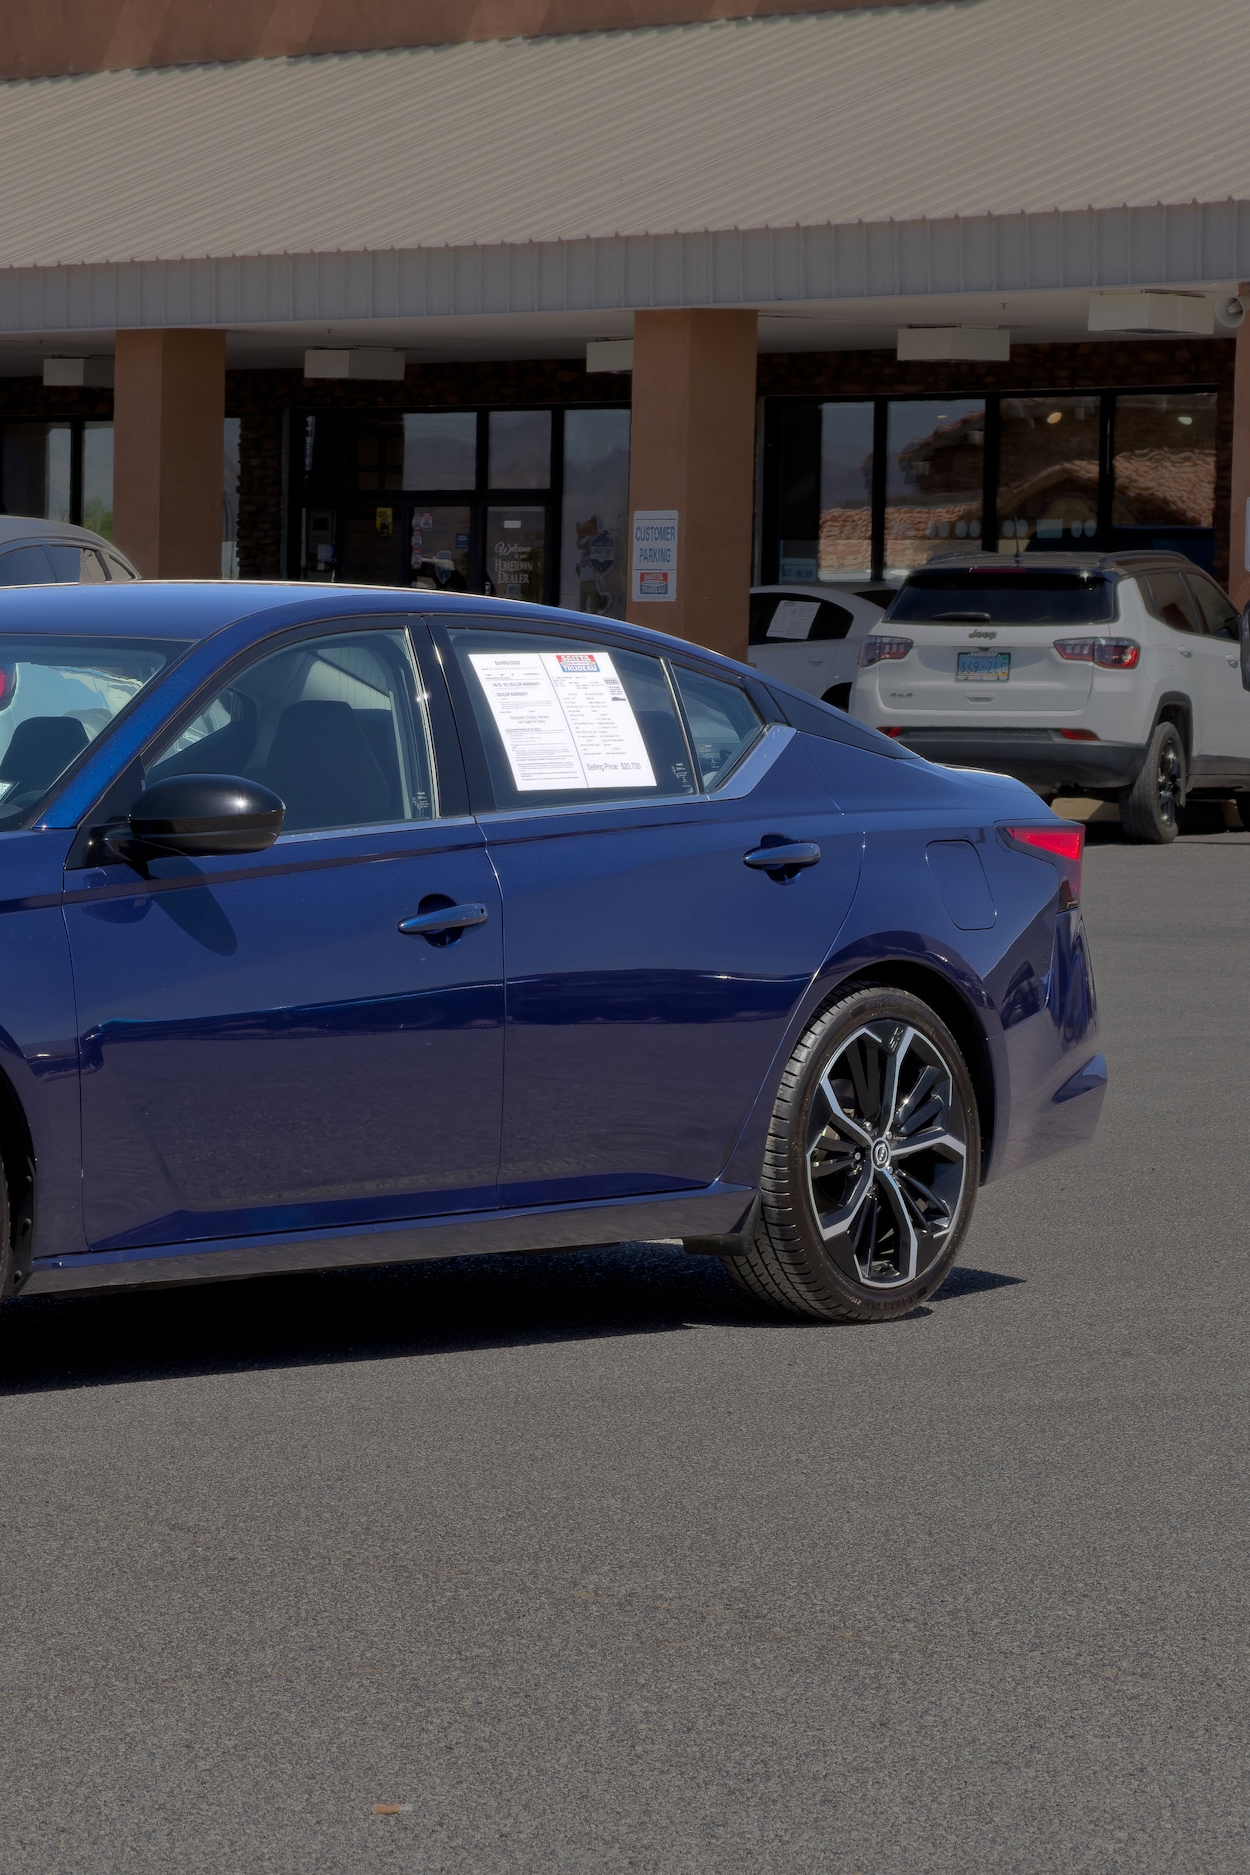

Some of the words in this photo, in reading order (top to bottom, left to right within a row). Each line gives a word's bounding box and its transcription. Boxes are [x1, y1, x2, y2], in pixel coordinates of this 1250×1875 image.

[635, 526, 676, 542] CUSTOMER
[494, 541, 532, 556] Welcome
[639, 547, 672, 563] PARKING
[495, 558, 533, 572] HOMETOWN
[498, 571, 530, 584] DEALER
[968, 629, 997, 641] Jeep
[561, 654, 590, 662] SAITTA
[563, 664, 598, 672] TRUDEAU
[586, 763, 604, 772] Selling
